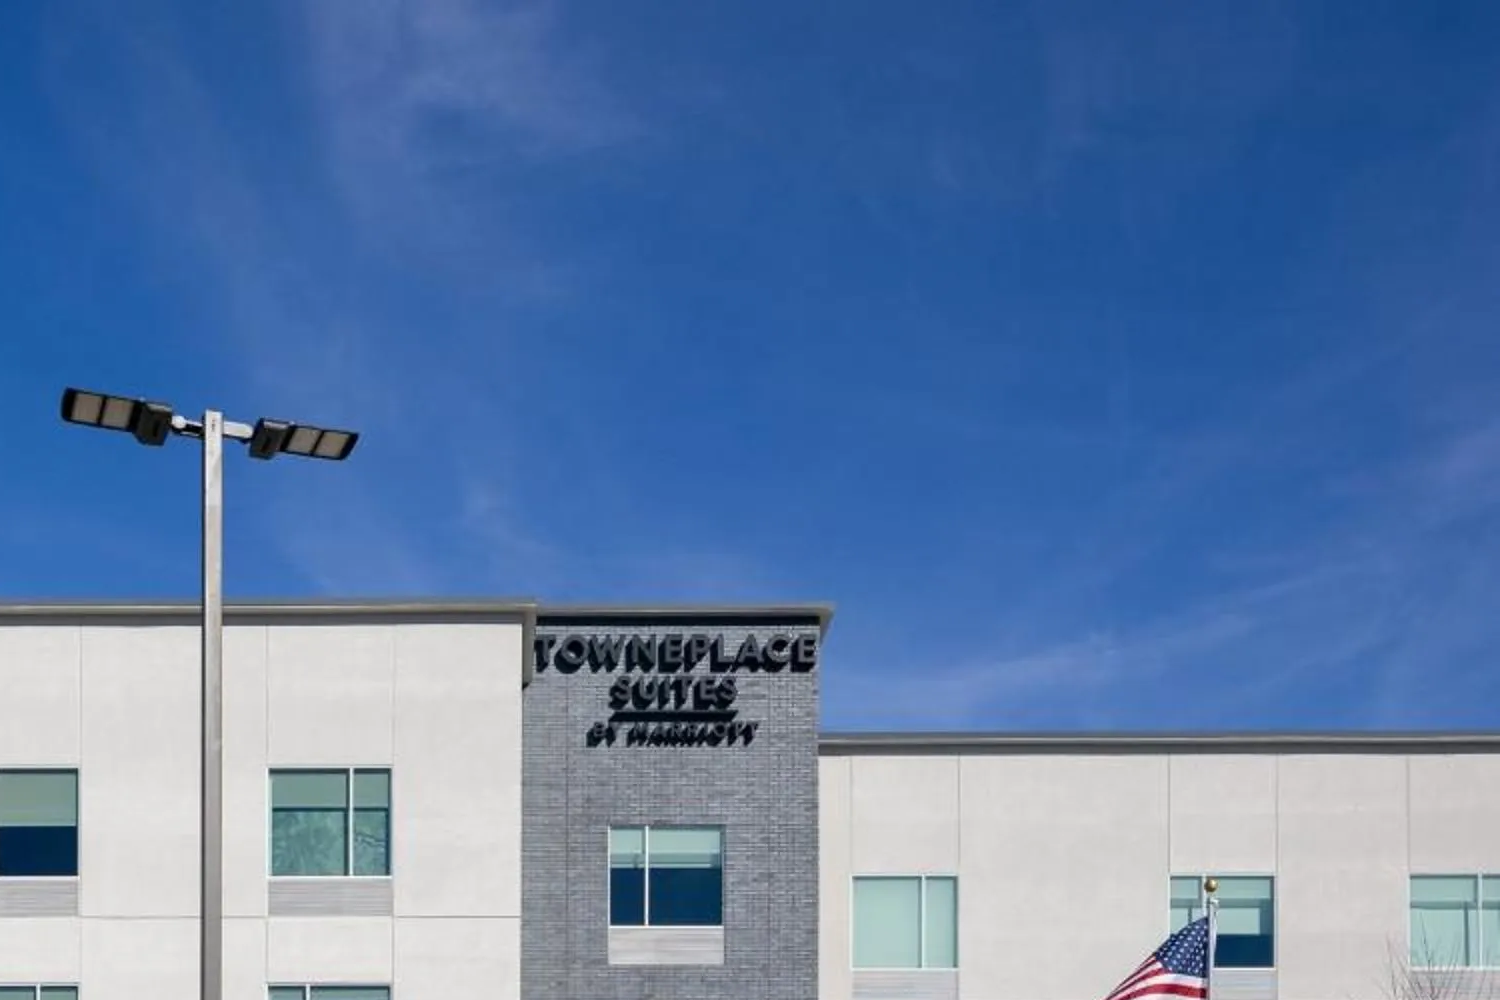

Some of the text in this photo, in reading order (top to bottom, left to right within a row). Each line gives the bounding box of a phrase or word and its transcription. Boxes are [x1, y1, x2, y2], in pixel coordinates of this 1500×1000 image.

[535, 633, 817, 671] TOWNEPLACE
[608, 675, 738, 708] SUITES
[586, 721, 759, 746] BY MARRIOTT
